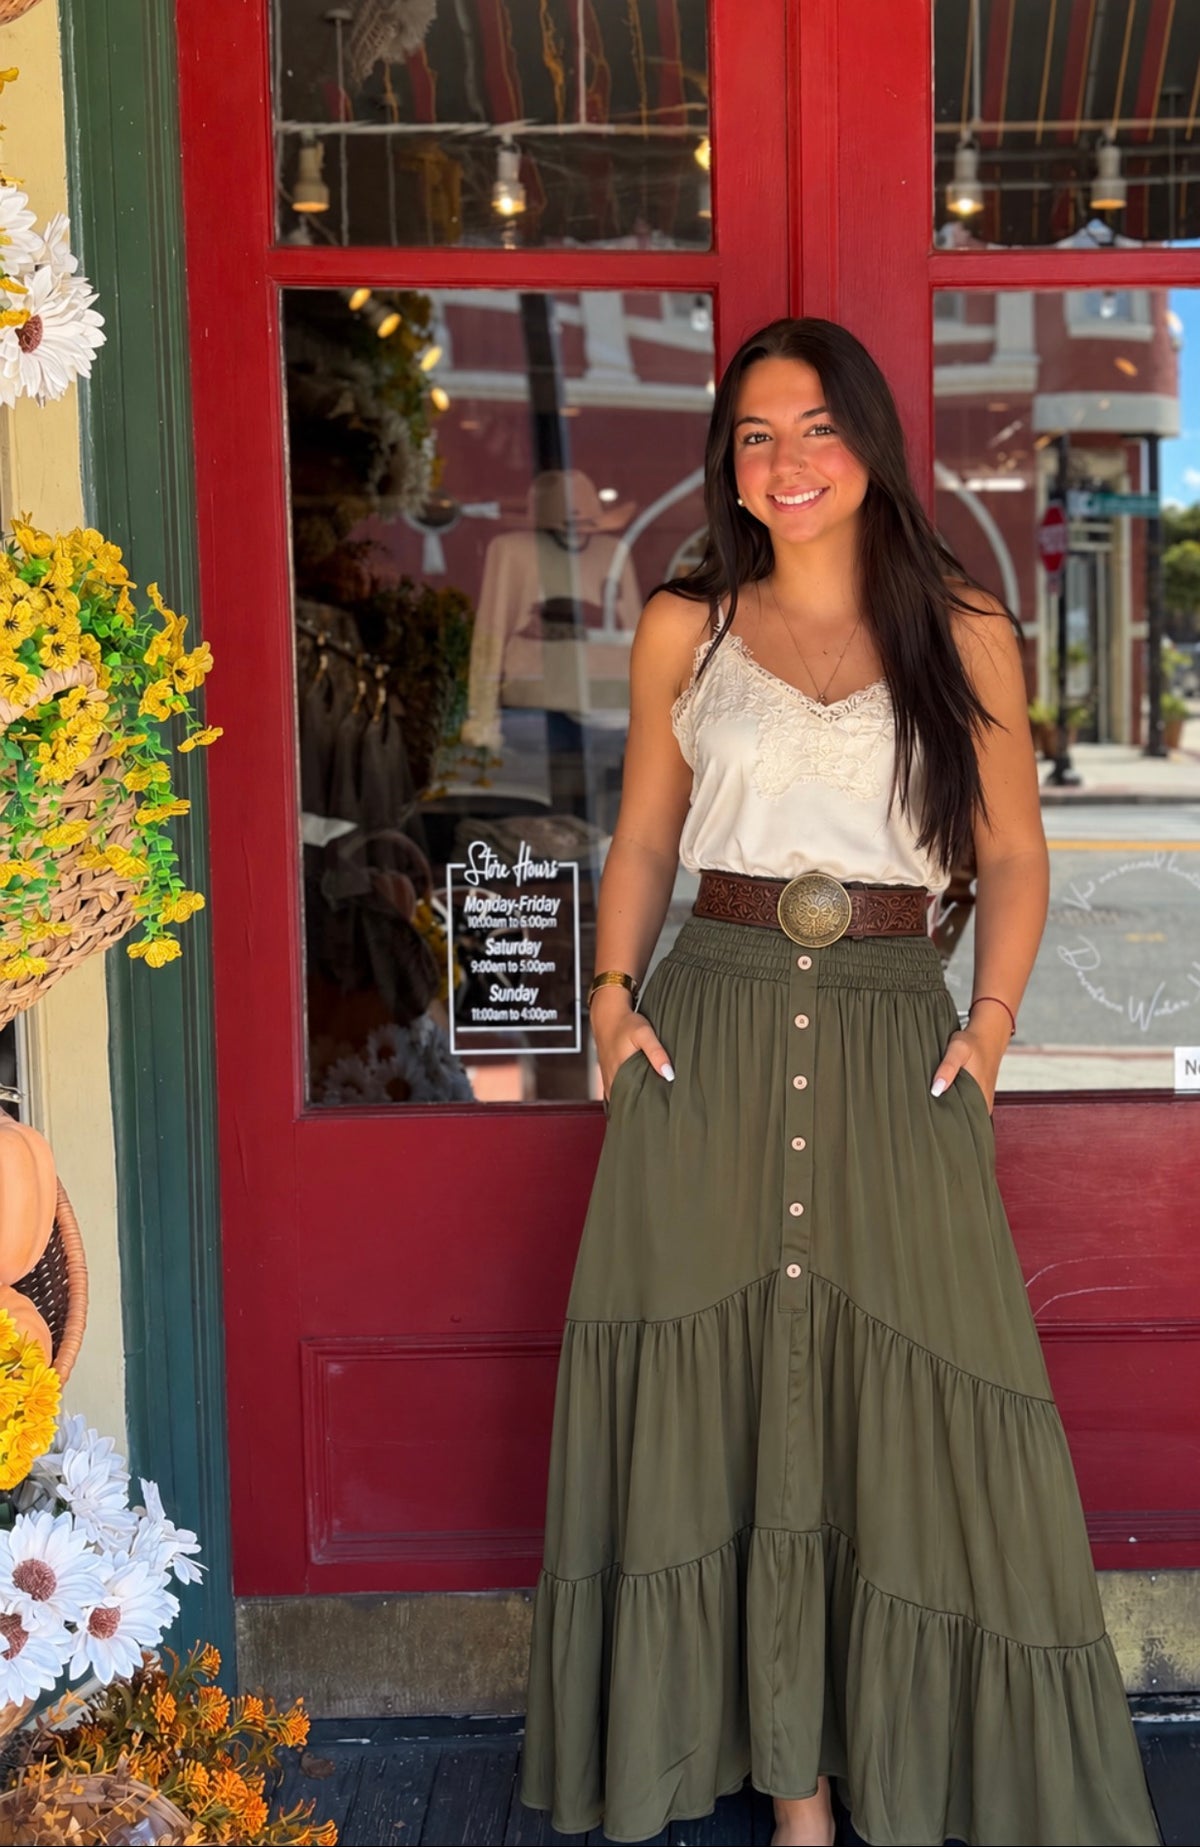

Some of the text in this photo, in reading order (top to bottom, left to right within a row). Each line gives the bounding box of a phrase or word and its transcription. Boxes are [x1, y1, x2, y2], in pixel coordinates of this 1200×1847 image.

[464, 841, 559, 887] Store Hours
[464, 895, 561, 916] Monday-Friday
[467, 916, 507, 929] 10:00am
[509, 916, 519, 929] to
[485, 937, 543, 958] Saturday
[470, 959, 556, 974] 9:00am to 5:00pm
[489, 983, 539, 1006] Sunday
[471, 1007, 558, 1023] 11:00am to 4:00pm
[1184, 1058, 1200, 1076] N
